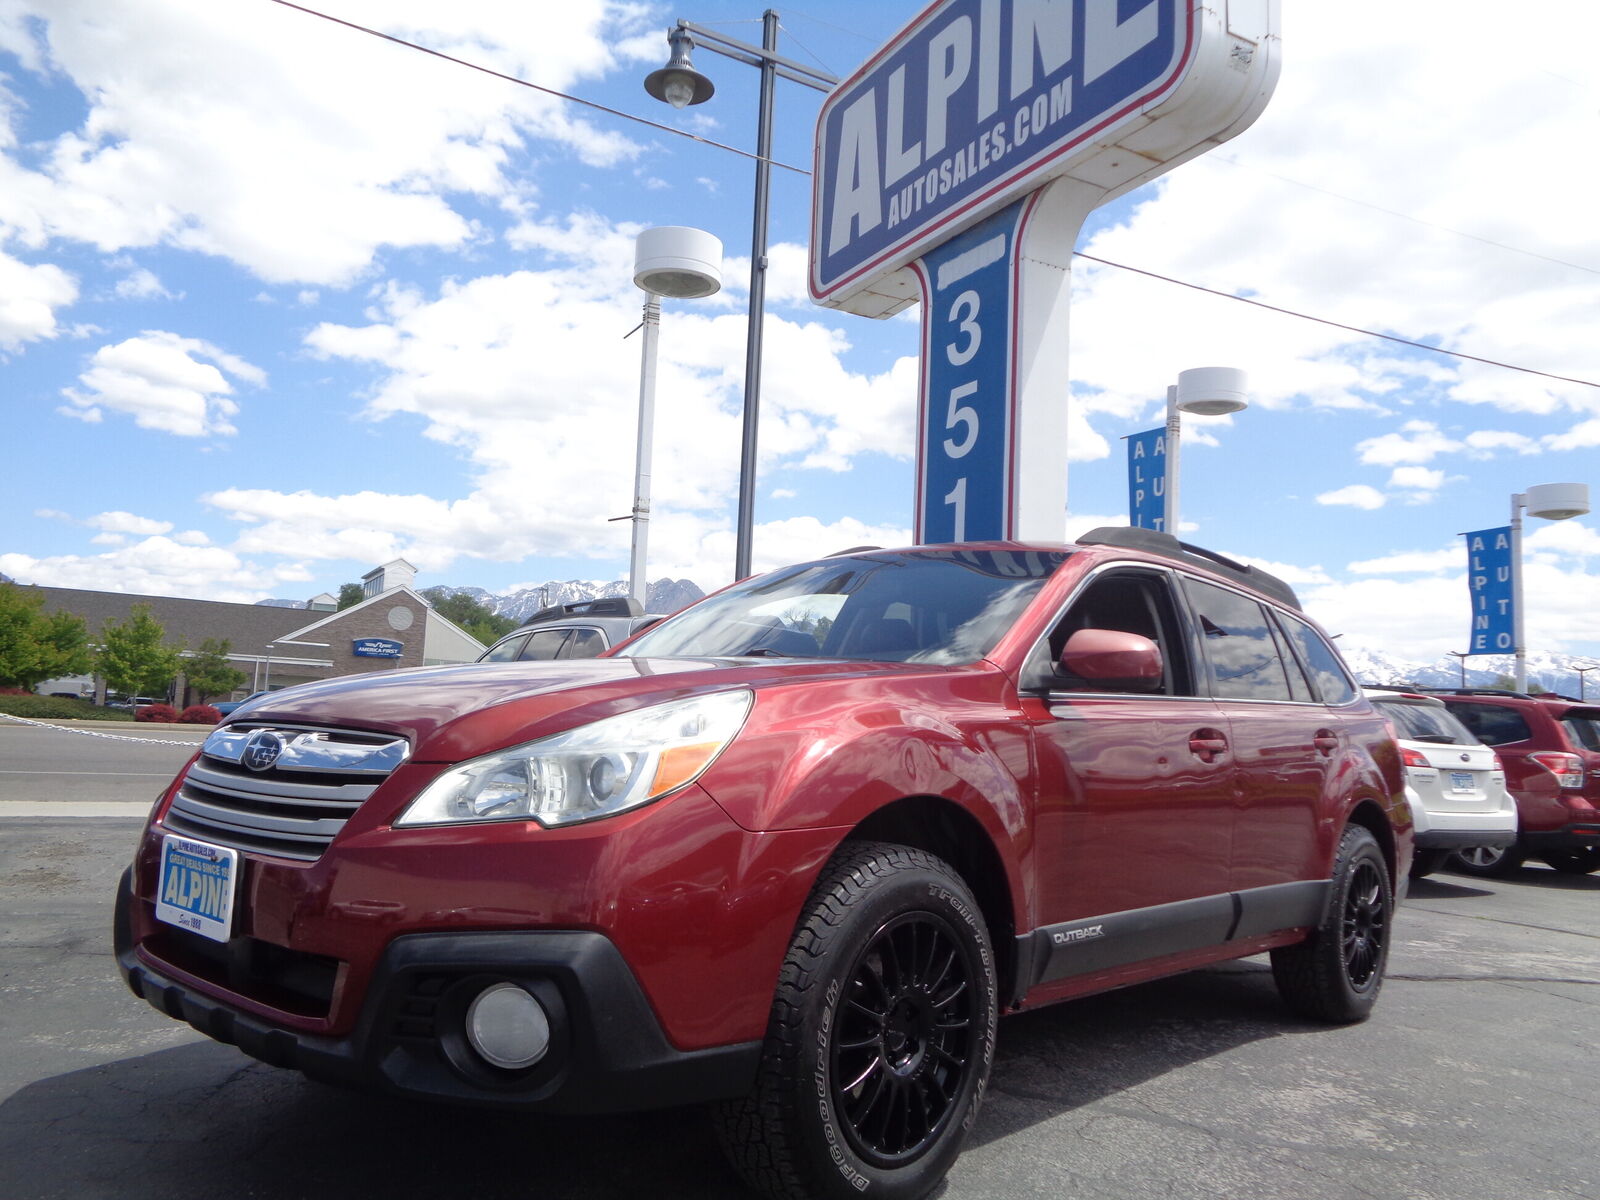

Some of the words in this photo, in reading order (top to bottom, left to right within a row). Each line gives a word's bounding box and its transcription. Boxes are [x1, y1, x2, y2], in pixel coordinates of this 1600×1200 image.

[888, 75, 1073, 230] AUTOSALES.COM
[1472, 536, 1489, 649] ALPINE
[1495, 533, 1511, 649] AUTO
[164, 866, 229, 918] ALPINE
[1053, 924, 1104, 944] OUTBACK
